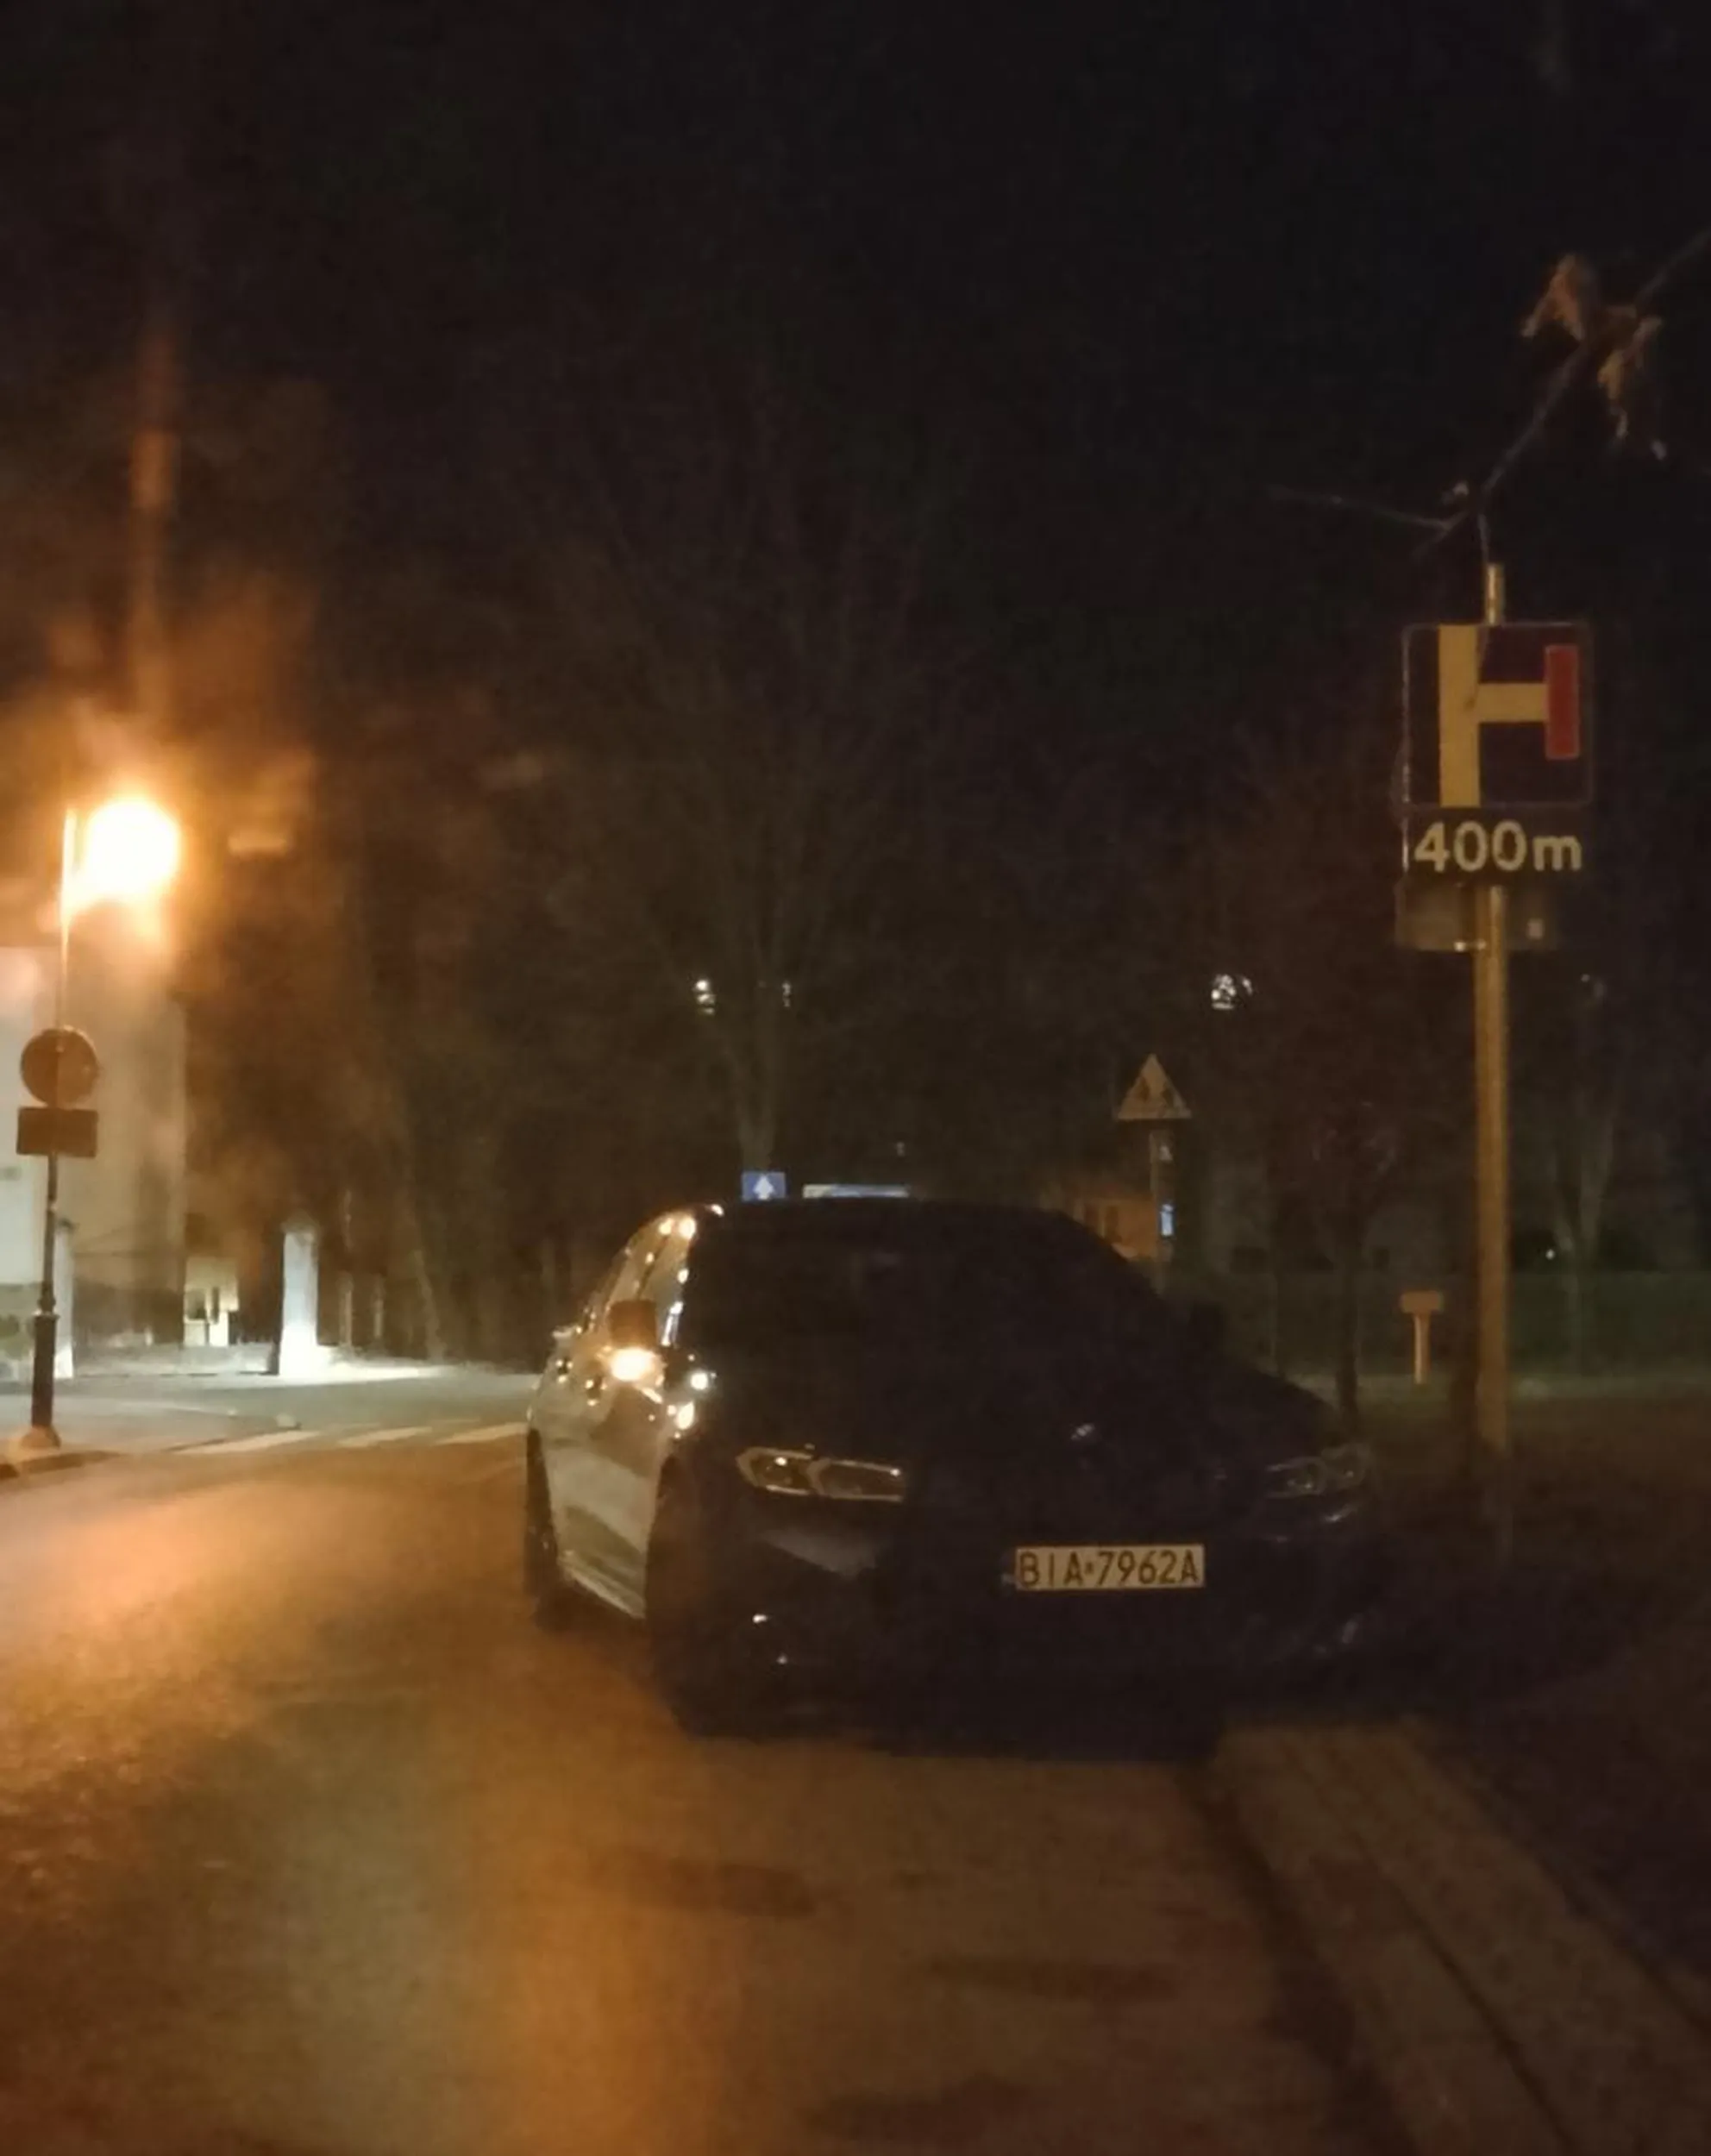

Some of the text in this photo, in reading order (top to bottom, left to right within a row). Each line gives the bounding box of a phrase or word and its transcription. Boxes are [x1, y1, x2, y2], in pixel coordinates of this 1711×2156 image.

[1413, 818, 1583, 873] 400m
[1019, 1549, 1198, 1586] BIA 7962A
